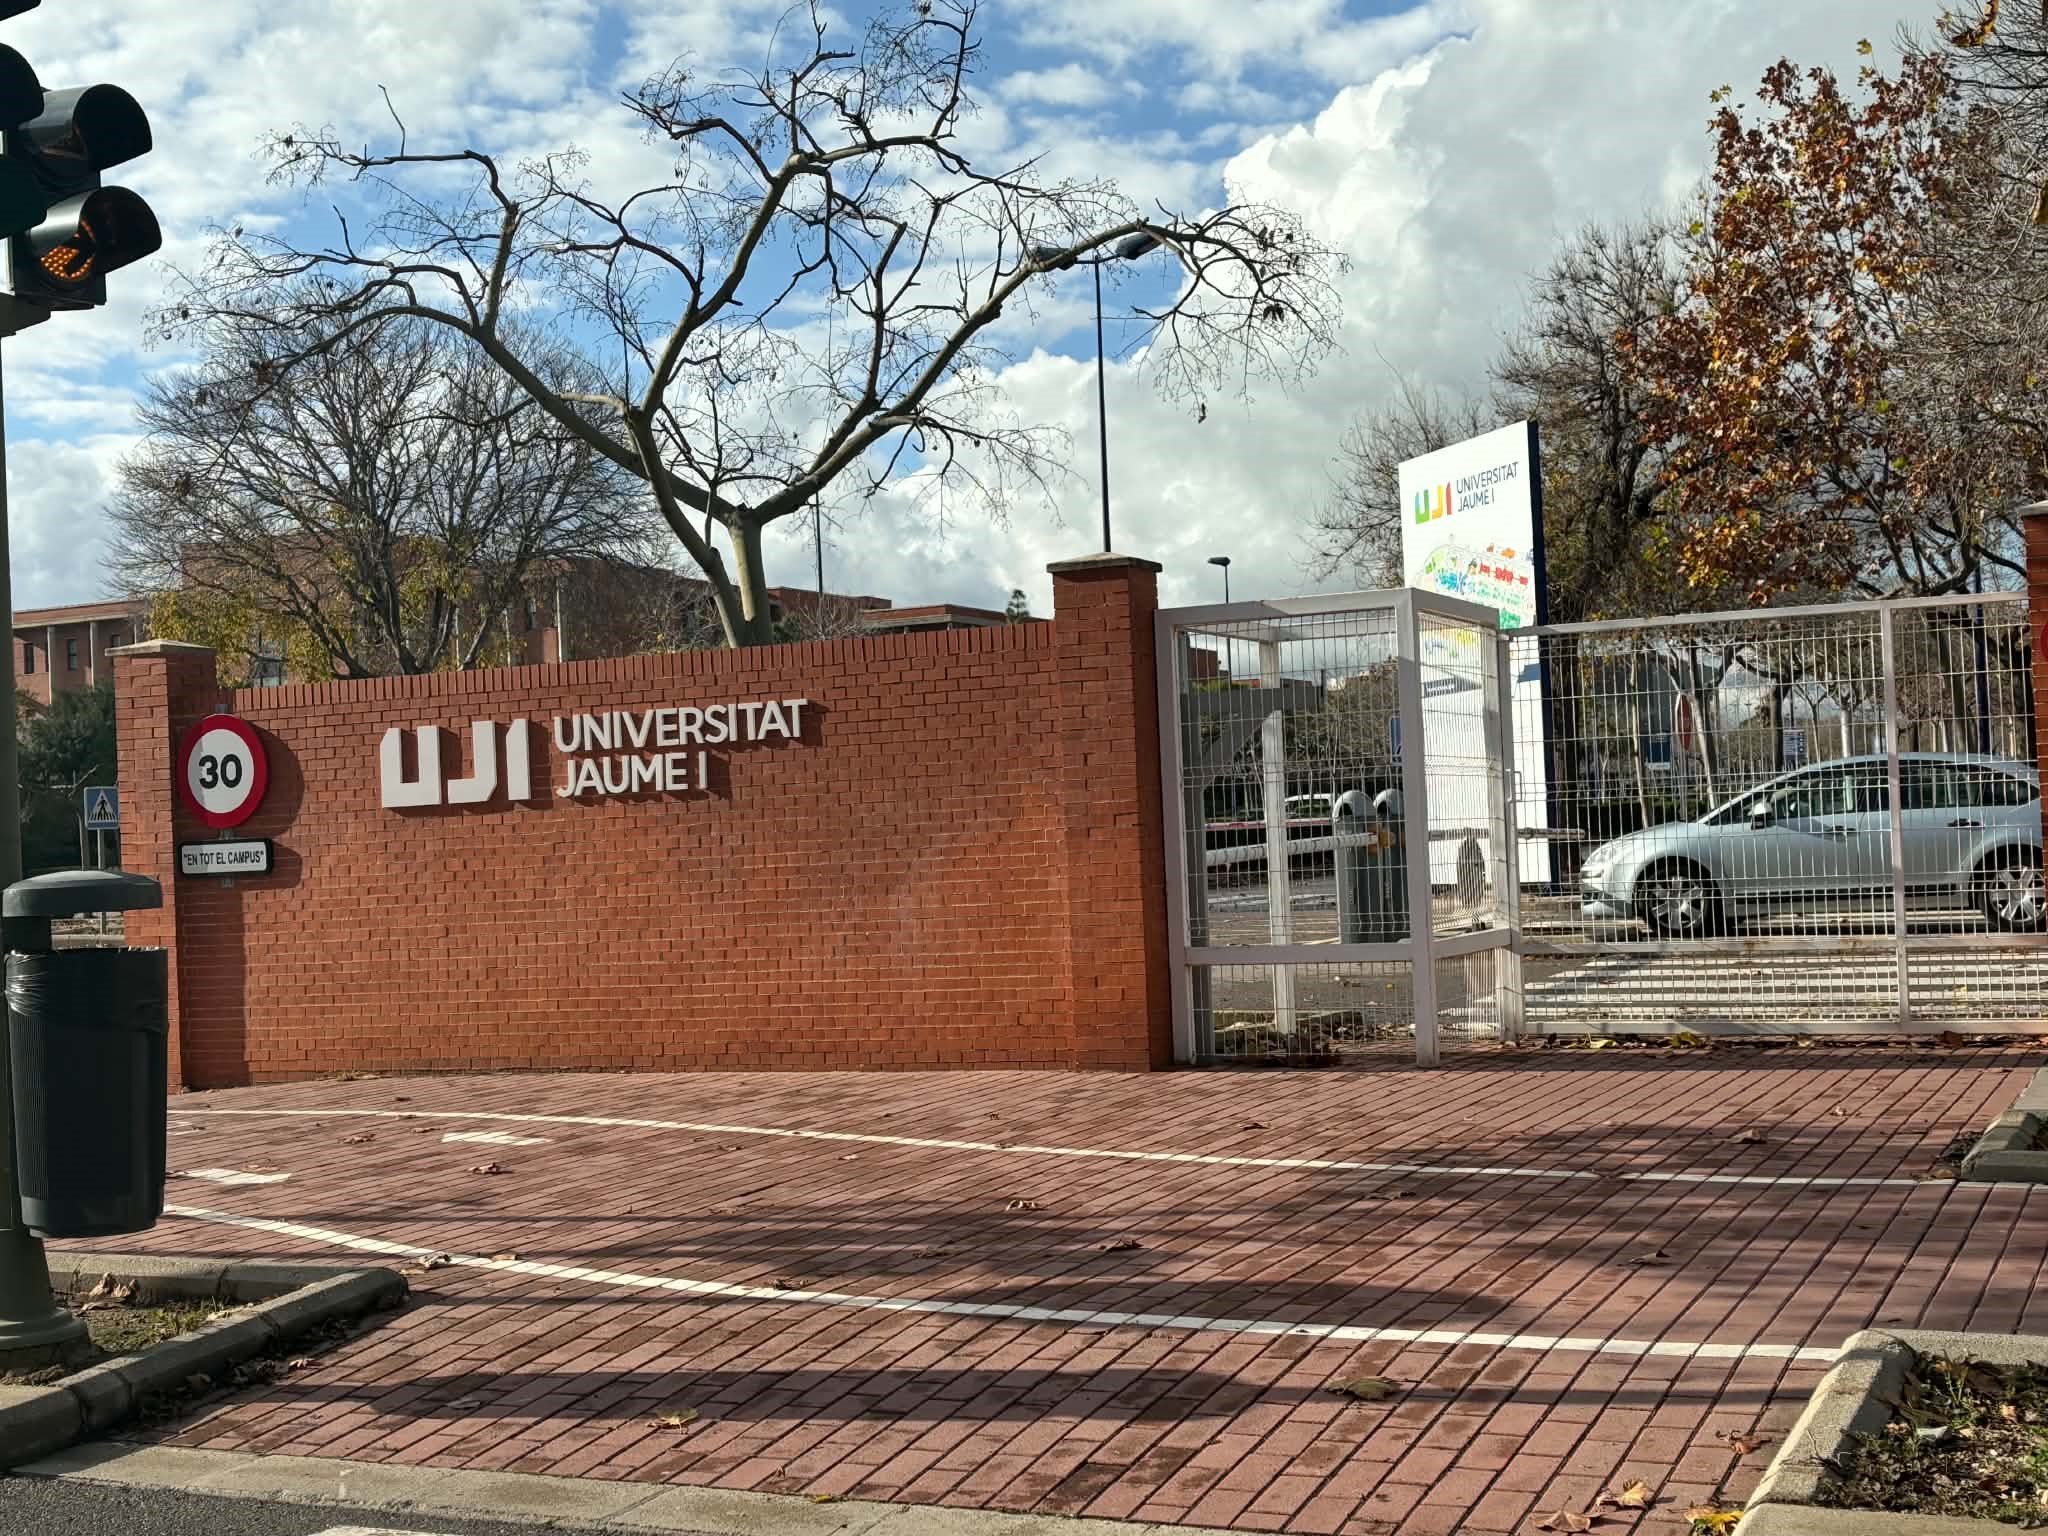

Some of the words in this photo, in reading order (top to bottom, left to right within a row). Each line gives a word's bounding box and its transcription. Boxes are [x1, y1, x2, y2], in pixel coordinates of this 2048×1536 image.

[1456, 461, 1519, 494] UNIVERSITAT
[1414, 482, 1453, 525] UJI
[1457, 489, 1490, 513] JAUME
[1491, 488, 1495, 504] I
[553, 698, 809, 753] UNIVERSITAT
[198, 753, 242, 790] 30
[380, 718, 532, 808] UJI
[555, 752, 688, 798] JAUME
[697, 750, 709, 790] I
[183, 853, 199, 866] "EN
[200, 853, 215, 865] TOT
[216, 852, 227, 865] EL
[228, 850, 265, 865] CAMPUS"
